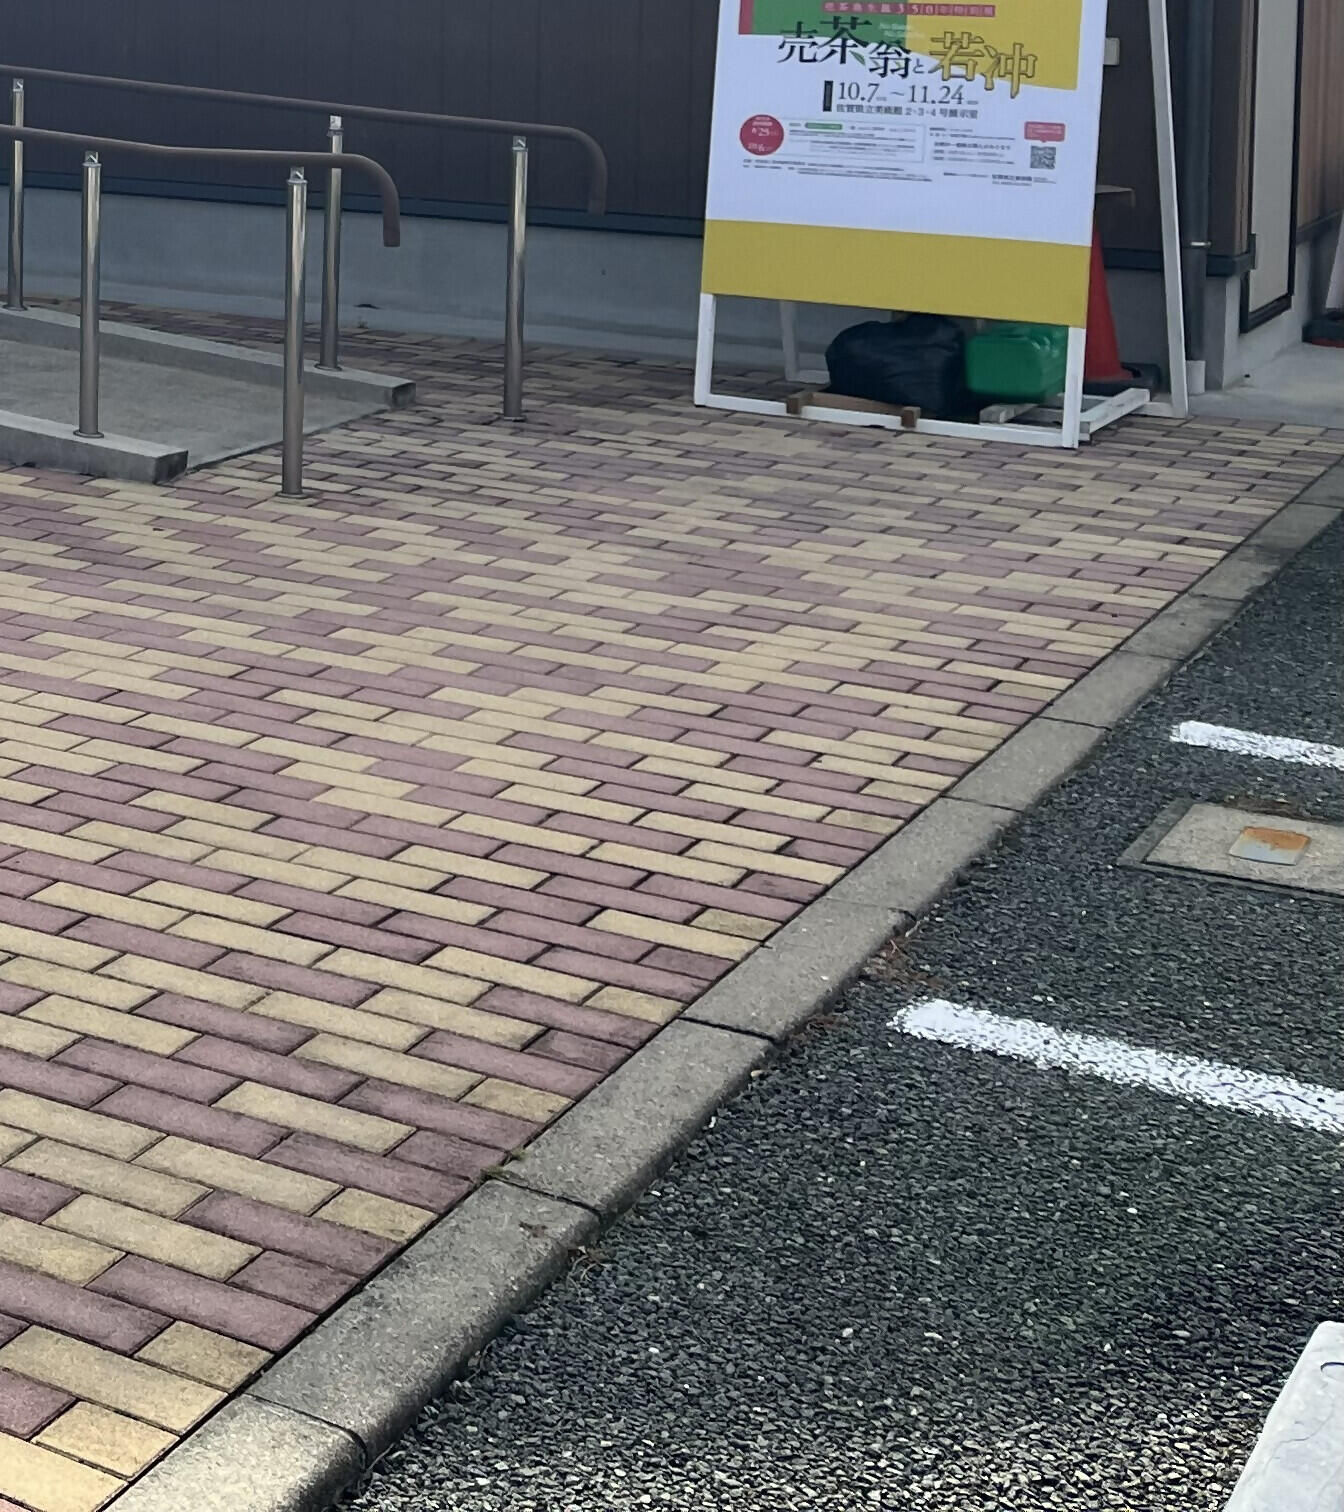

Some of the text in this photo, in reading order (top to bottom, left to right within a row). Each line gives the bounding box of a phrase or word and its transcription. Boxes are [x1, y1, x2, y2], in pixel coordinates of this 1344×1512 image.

[777, 15, 1038, 99] 売茶翁と若冲
